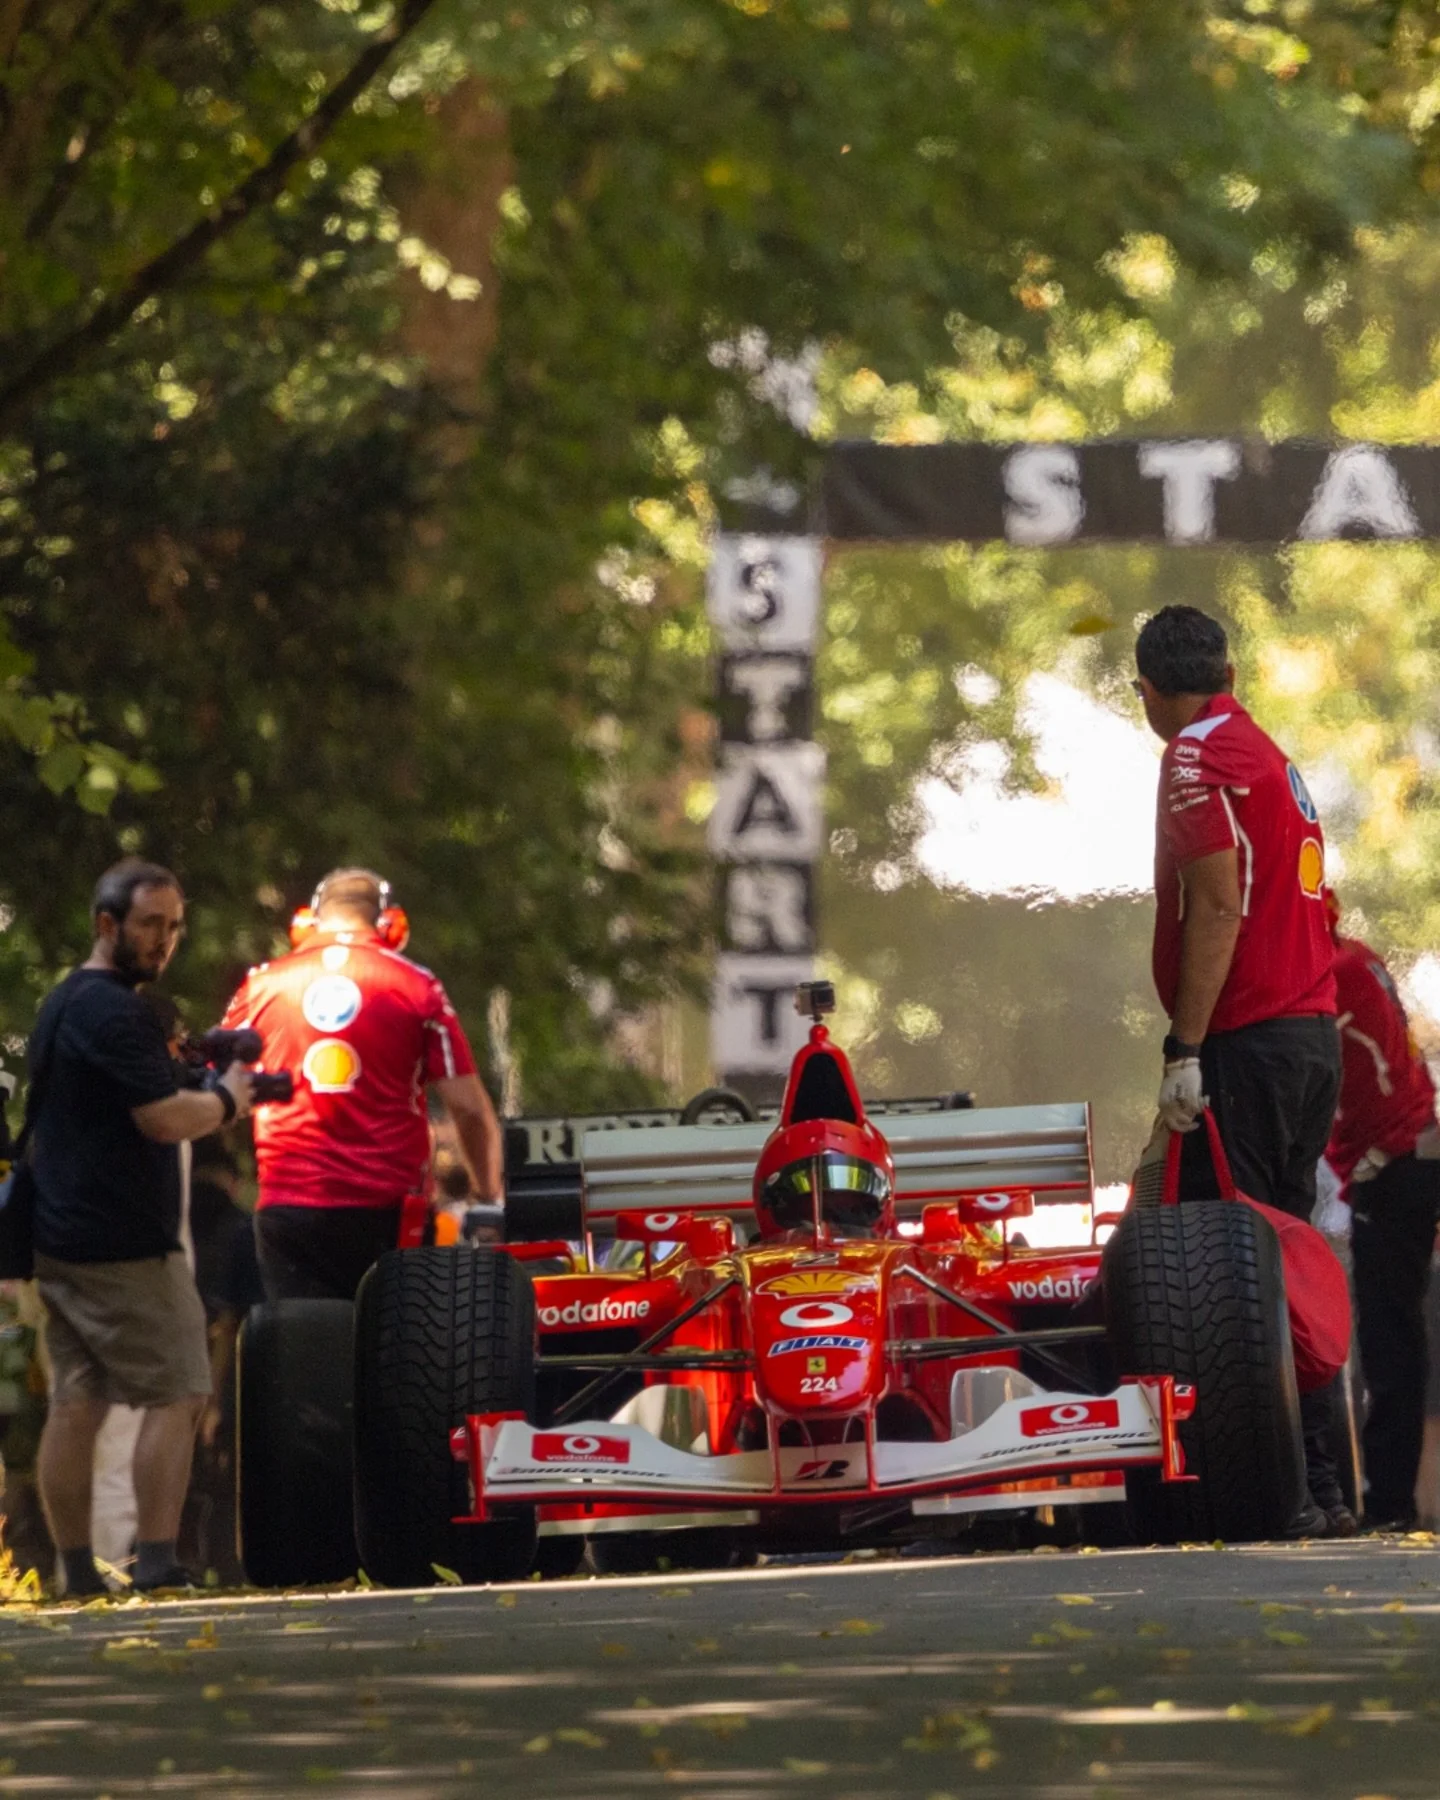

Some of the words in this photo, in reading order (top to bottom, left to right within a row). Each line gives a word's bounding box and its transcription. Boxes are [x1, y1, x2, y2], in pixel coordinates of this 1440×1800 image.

[724, 556, 808, 1042] START
[773, 1337, 861, 1353] FIAT
[800, 1376, 838, 1393] 224
[546, 1453, 617, 1462] vodafone
